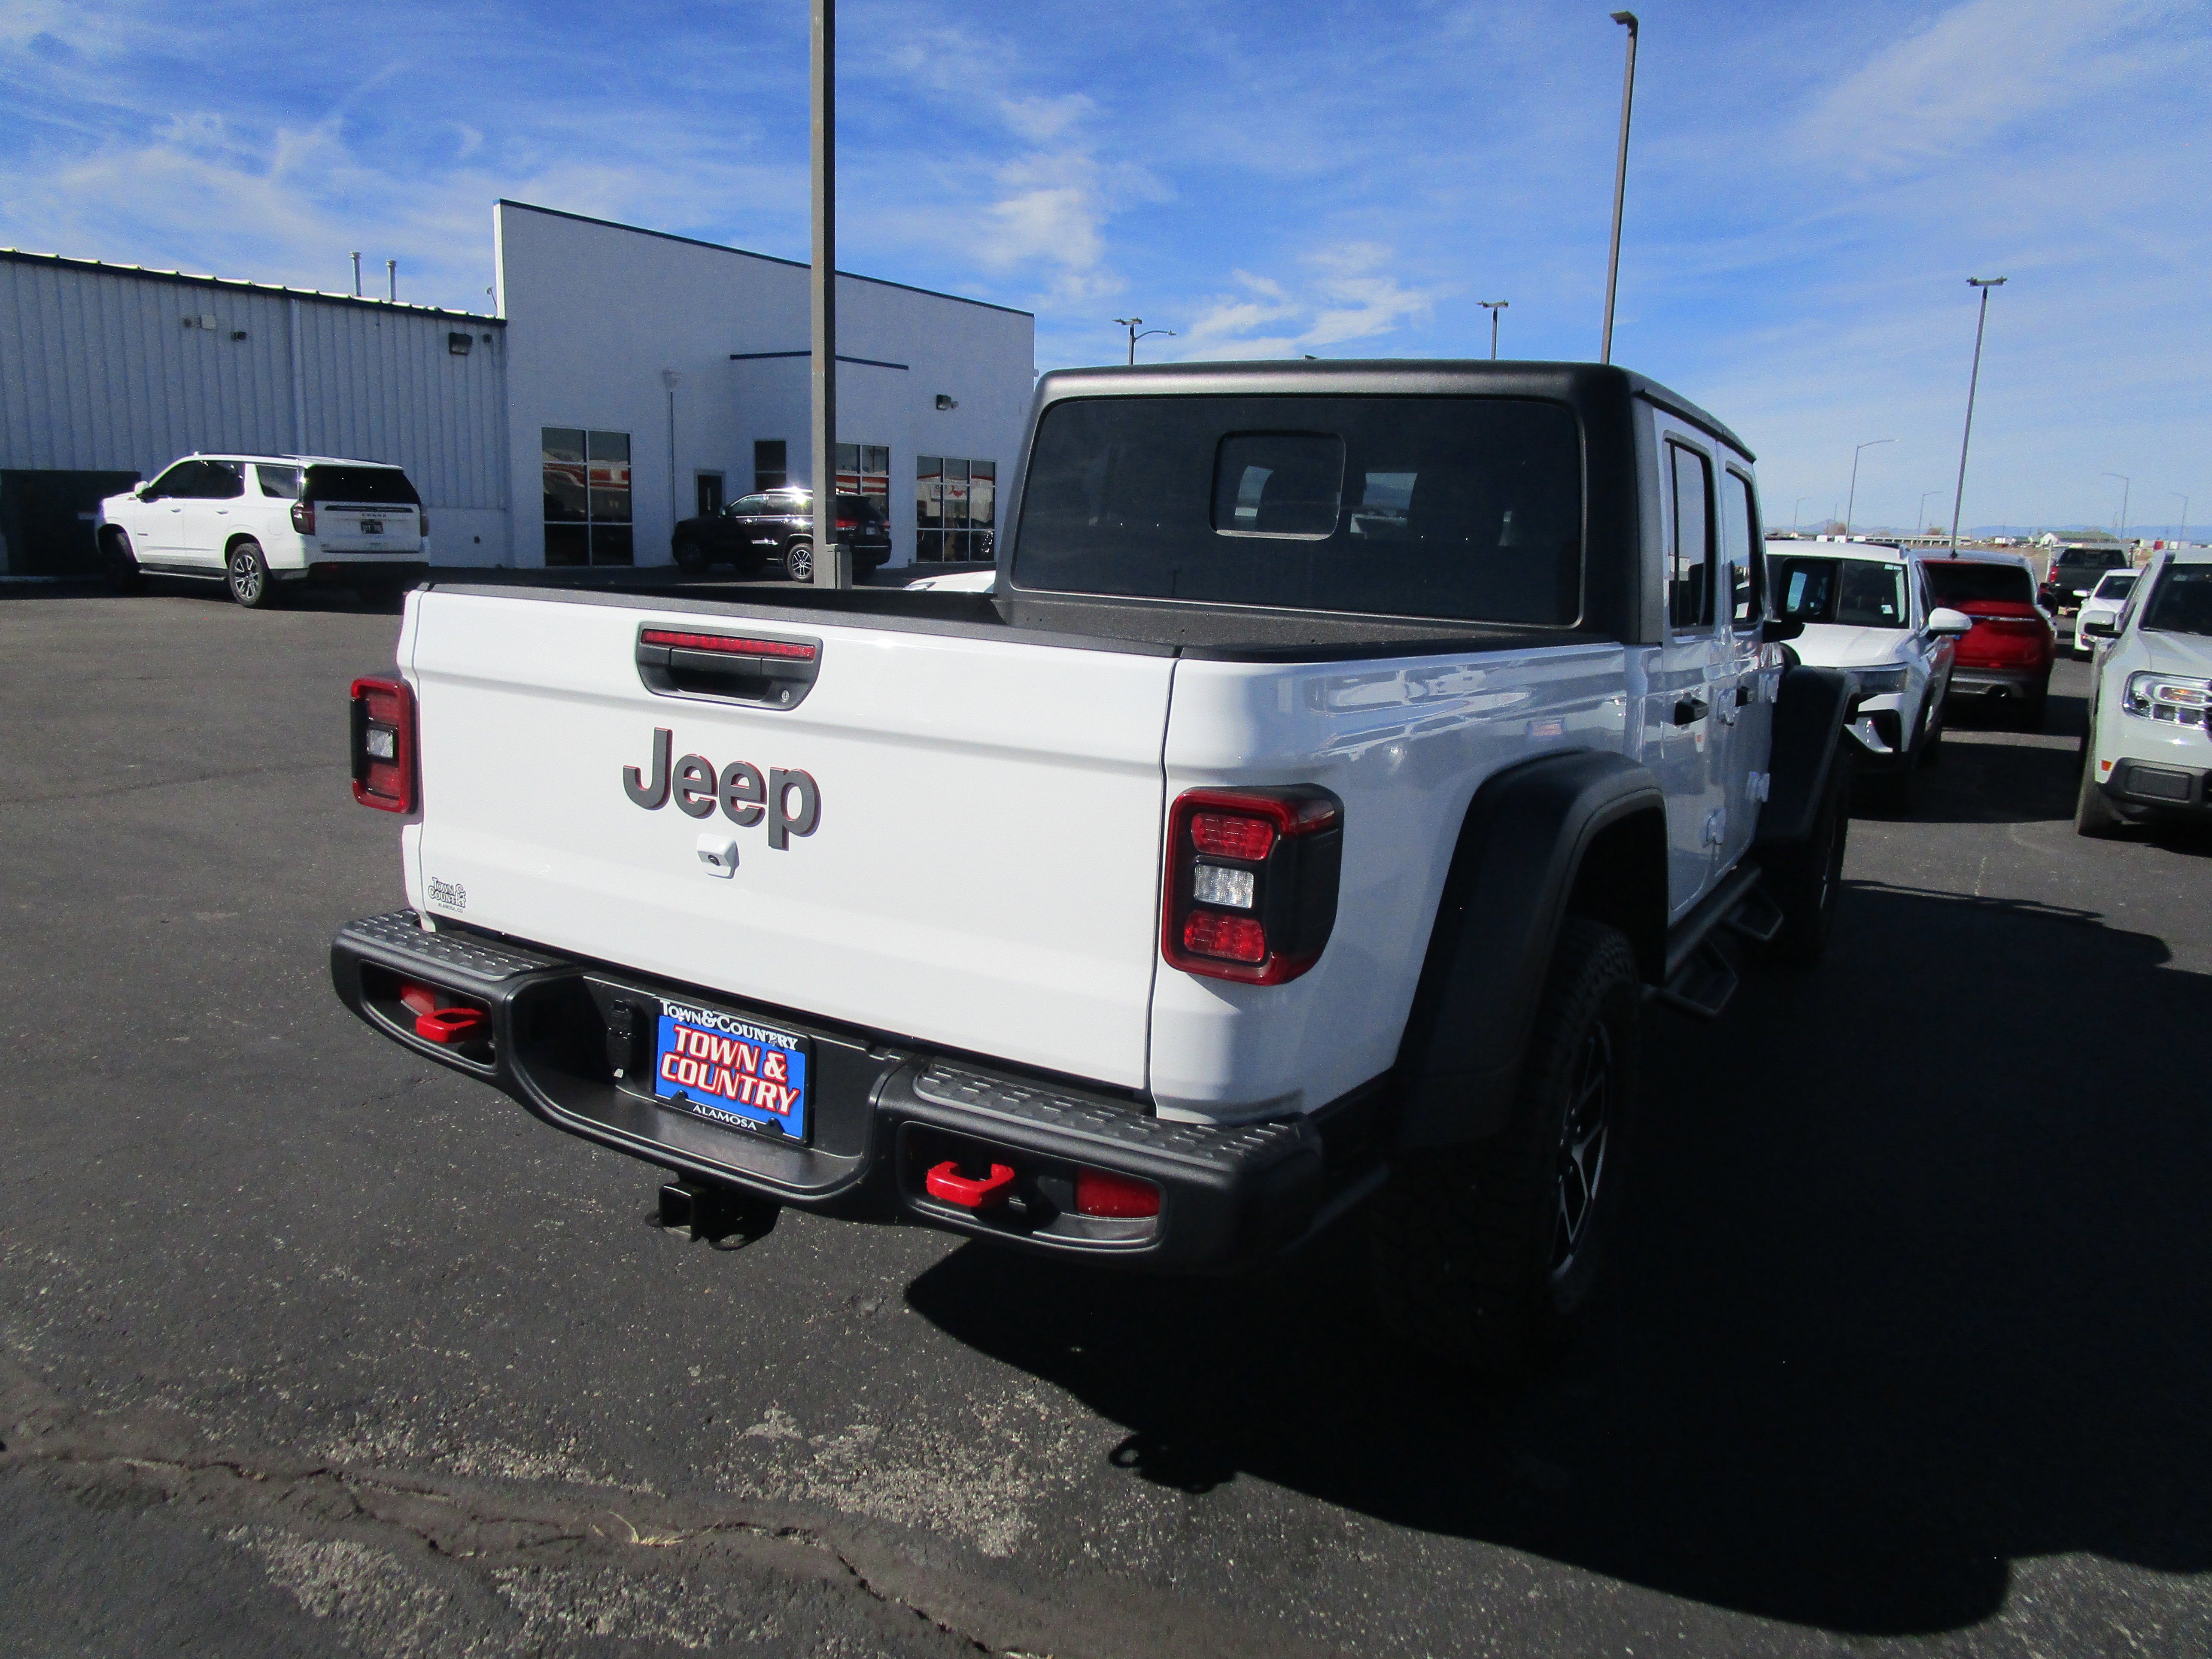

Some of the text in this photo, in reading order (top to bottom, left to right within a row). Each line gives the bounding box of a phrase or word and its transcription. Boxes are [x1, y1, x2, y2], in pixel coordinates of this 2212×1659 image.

[623, 727, 821, 851] Jeep
[428, 885, 466, 908] COUNTRY
[431, 877, 455, 896] TOWN
[673, 1024, 787, 1083] TOWN &
[660, 1052, 800, 1115] COUNTRY
[693, 1104, 757, 1131] ALAMOSA
